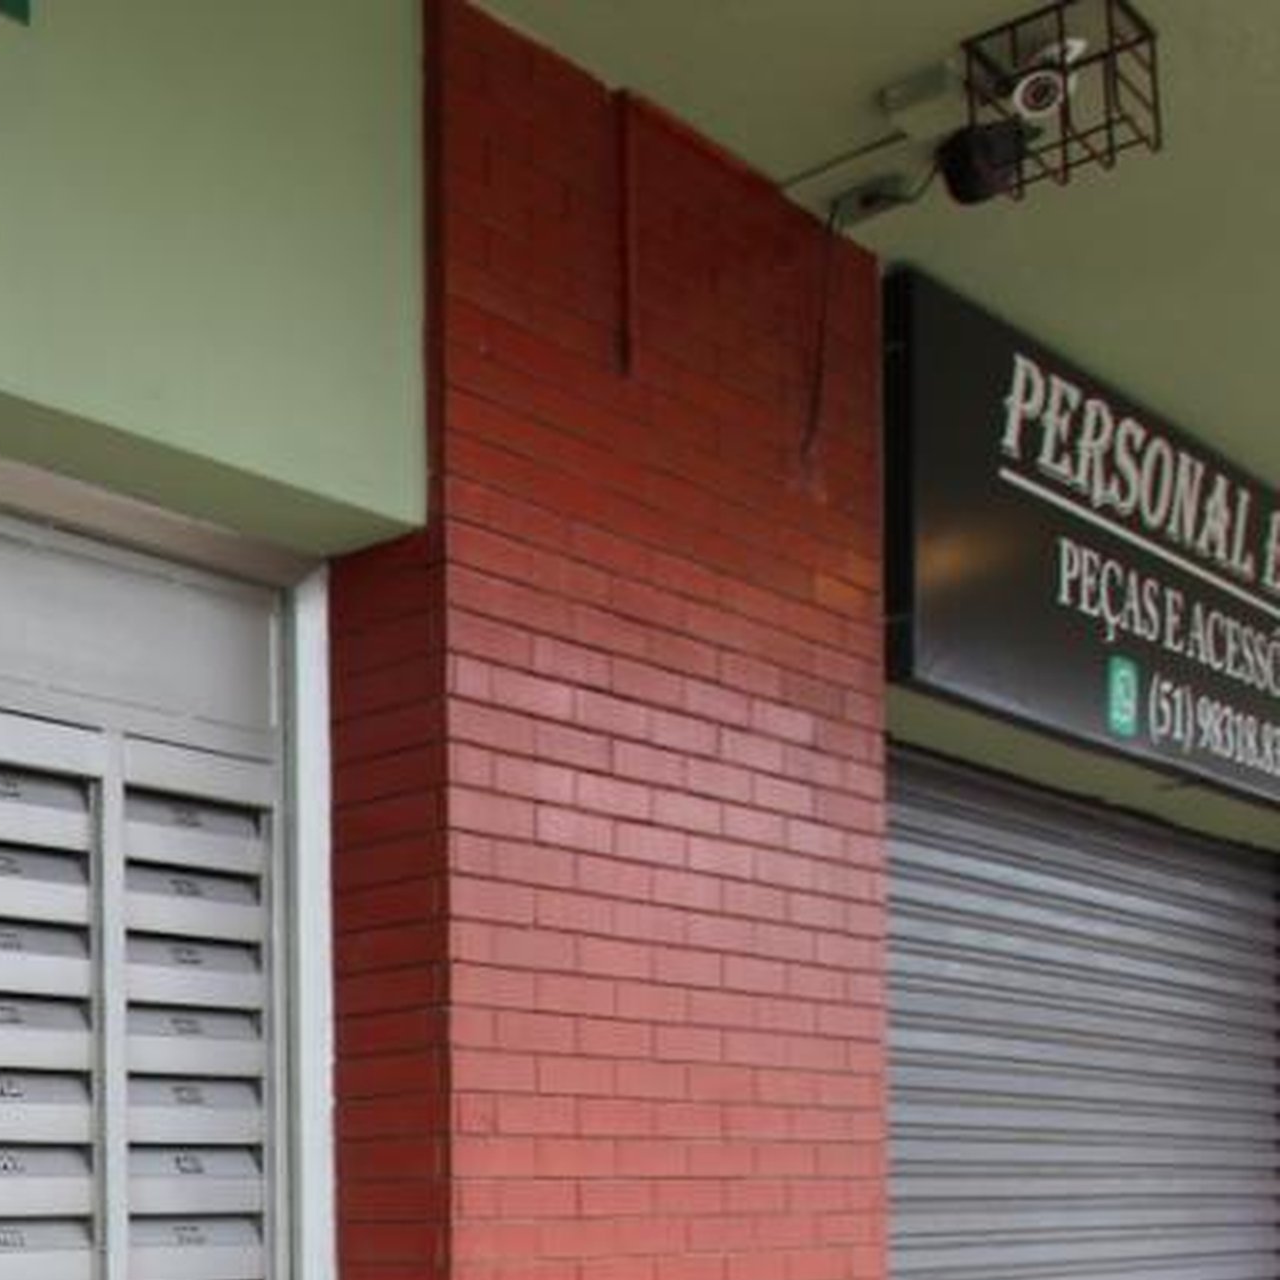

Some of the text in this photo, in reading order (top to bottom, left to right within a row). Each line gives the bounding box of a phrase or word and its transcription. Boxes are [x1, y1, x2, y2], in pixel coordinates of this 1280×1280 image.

[1002, 352, 1254, 583] PERSONAL
[1057, 536, 1160, 641] PEÇAS
[1164, 587, 1185, 653] E
[1149, 672, 1194, 754] (51)
